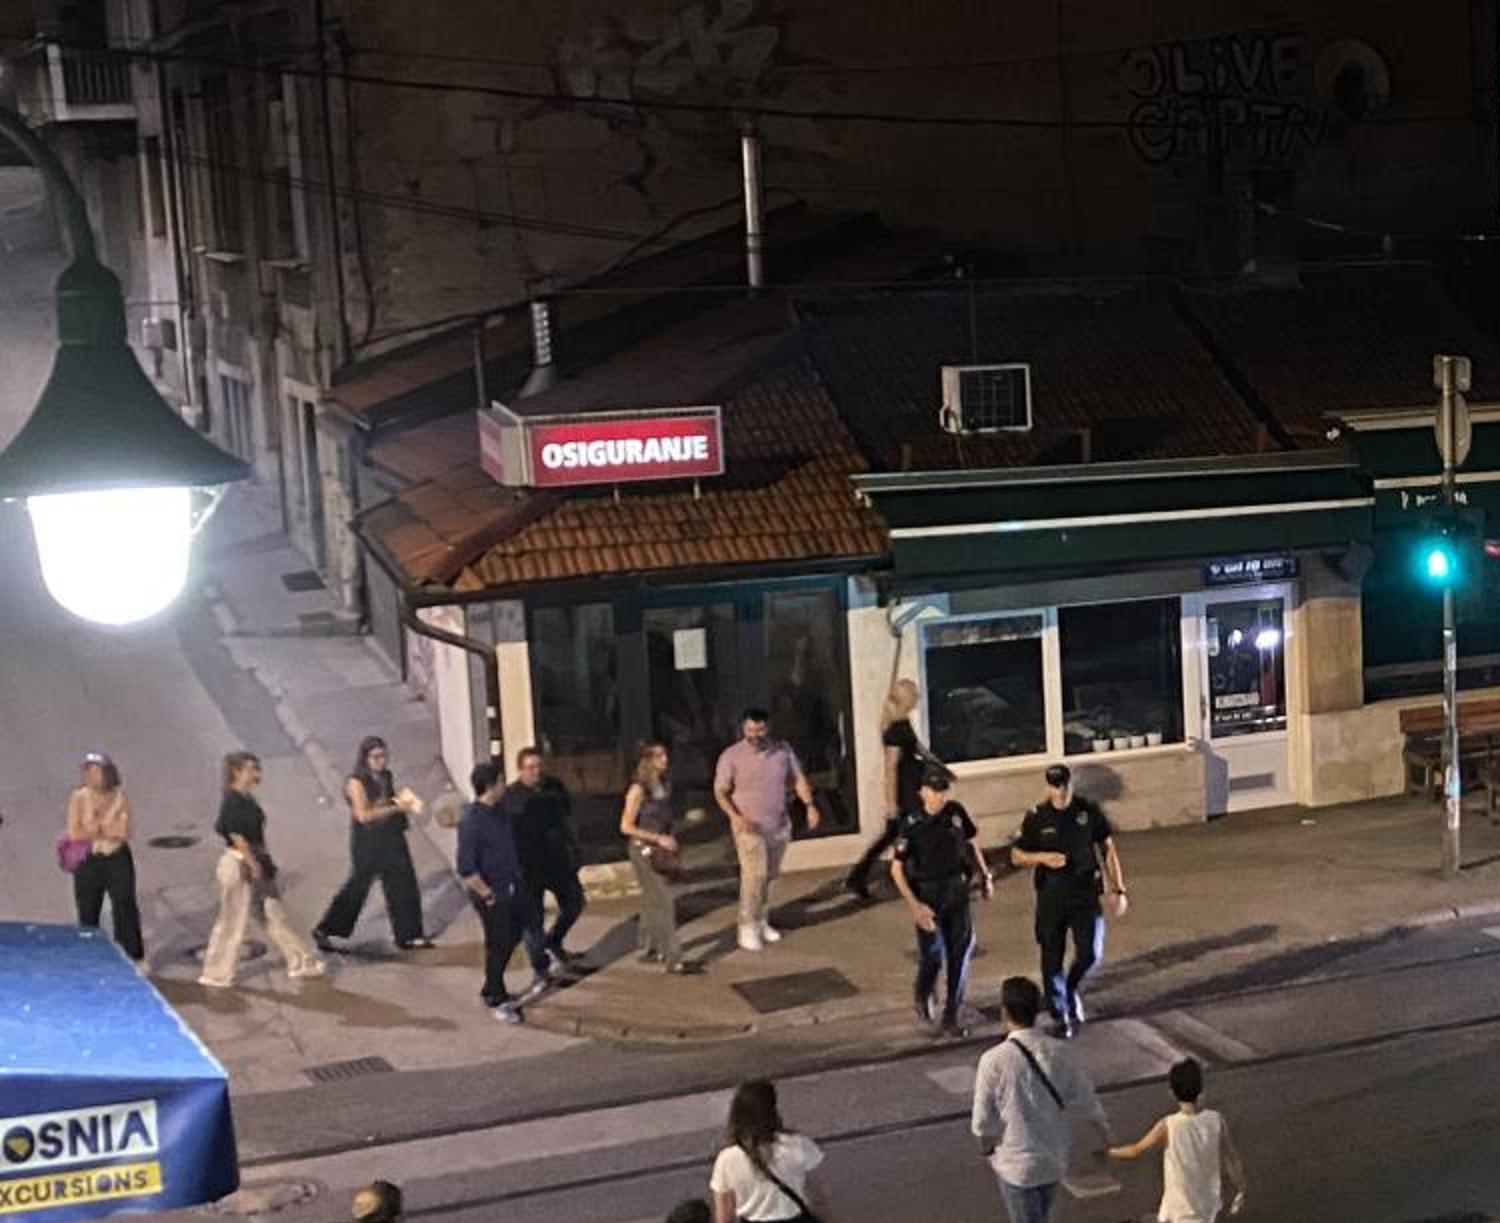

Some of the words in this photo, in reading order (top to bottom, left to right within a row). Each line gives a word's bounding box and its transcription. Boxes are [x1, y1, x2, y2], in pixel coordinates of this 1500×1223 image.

[541, 435, 709, 468] OSIGURANJE
[2, 1110, 154, 1164] OSNIA
[0, 1170, 148, 1207] XCURSIONS
